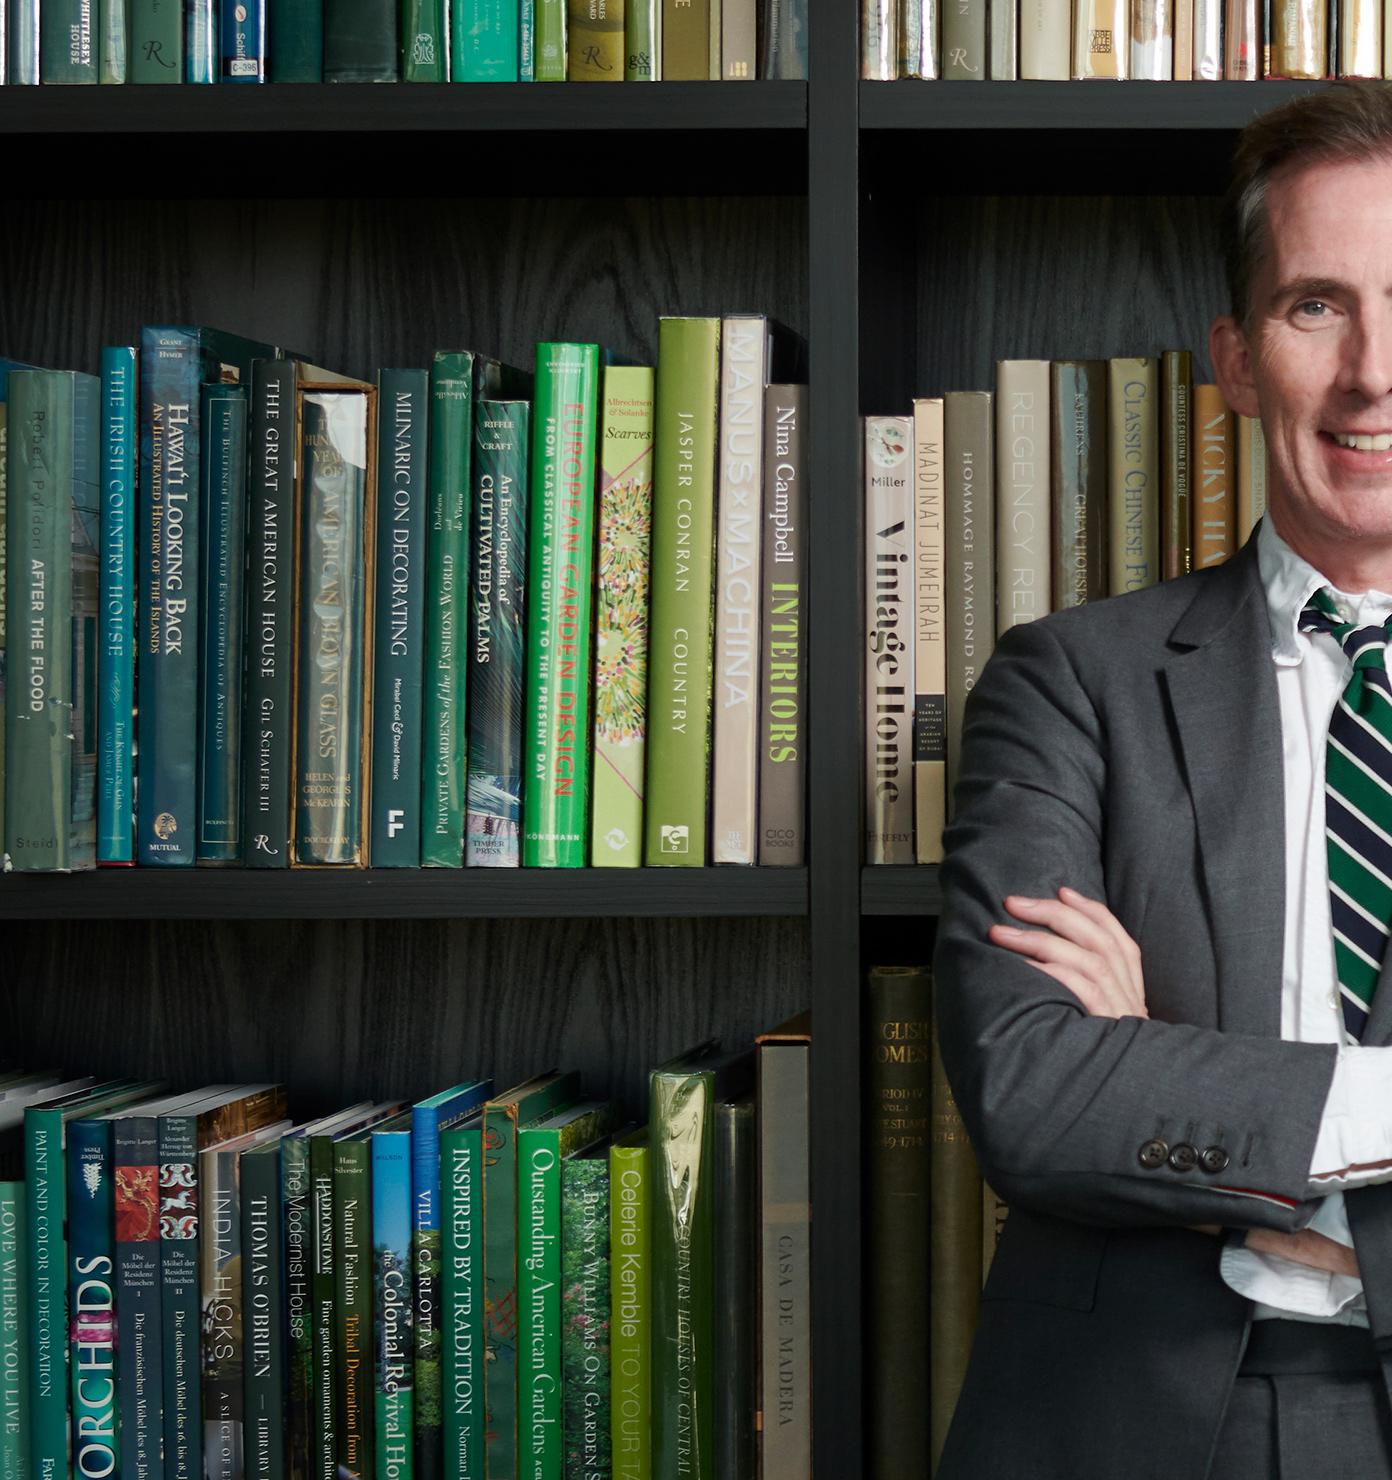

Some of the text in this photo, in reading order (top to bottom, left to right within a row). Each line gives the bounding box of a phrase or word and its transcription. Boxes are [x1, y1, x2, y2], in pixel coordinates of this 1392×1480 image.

[71, 24, 80, 65] HOUSE
[109, 367, 125, 656] THE IRISH COUNTRY HOUSE
[151, 403, 165, 653] AN ILLUSTRATED HISTORY OF THE ISLANDS
[166, 493, 188, 591] LOOKING
[261, 380, 279, 677] THE GREAT AMERICAN HOUSE
[391, 393, 411, 655] MLINARIC ON DECORATING
[477, 475, 493, 663] CULTIVATED PALMS
[496, 475, 512, 604] An Encyclopedia of
[676, 412, 693, 591] JASPER CONRAN
[770, 407, 795, 563] Nina Campbell
[872, 474, 905, 488] Miller
[917, 439, 941, 641] MADINAT JUMEIRAH
[30, 560, 46, 711] AFTER THE FLOOD
[166, 598, 186, 655] BACK
[672, 628, 688, 733] COUNTRY
[769, 583, 800, 762] INTERIORS
[869, 520, 909, 803] Vintage Home
[260, 699, 274, 810] GIL SCHAFER III
[150, 840, 181, 851] MUTUAL
[2, 1201, 19, 1434] LOVE WHERE YOU LIVE
[36, 1131, 51, 1396] PAINT AND COLOR IN DECORATION
[251, 1196, 267, 1285] THOMAS
[344, 1200, 358, 1304] Natural Fashion
[453, 1149, 472, 1414] INSPIRED BY TRADITION
[526, 1148, 555, 1454] Outstanding American Gardens
[618, 1170, 641, 1337] Celerie Kemble
[73, 1256, 116, 1478] ORCHIDS
[779, 1235, 793, 1426] CASA DE MADERA
